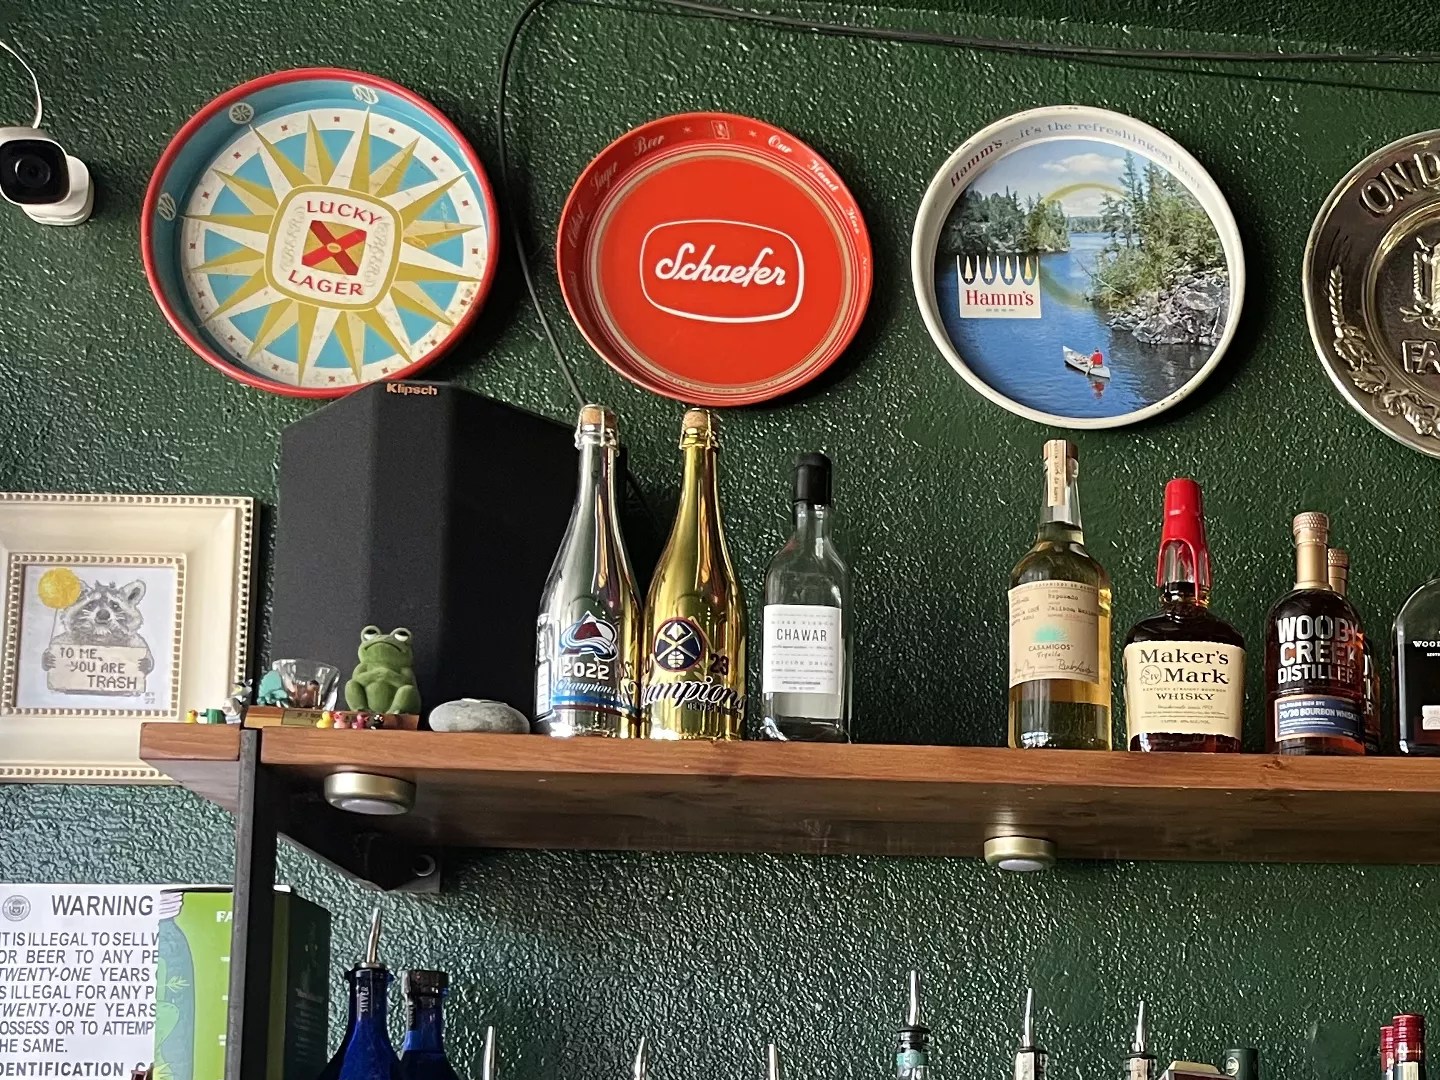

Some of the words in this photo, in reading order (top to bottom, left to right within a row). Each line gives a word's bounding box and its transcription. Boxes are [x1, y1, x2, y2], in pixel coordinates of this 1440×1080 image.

[1047, 121, 1072, 132] the
[1360, 162, 1419, 217] ON
[307, 200, 382, 225] LUCKY
[655, 242, 786, 288] Schaefer
[288, 269, 364, 296] LAGER
[965, 289, 1034, 307] Hamm's
[386, 382, 438, 396] Klipsch
[776, 628, 828, 642] CHAWAR
[1277, 615, 1360, 644] WOODY
[60, 647, 75, 659] TO
[1028, 643, 1071, 652] CASAMIGOS
[1280, 640, 1356, 668] CREEK
[1139, 649, 1229, 665] Maker's
[70, 661, 97, 673] YOU
[101, 661, 126, 674] ARE
[563, 662, 609, 681] 2022
[87, 675, 138, 690] TRASH
[1165, 668, 1229, 684] Mark
[1157, 692, 1215, 701] WHISKY
[51, 895, 153, 916] WARNING
[28, 932, 88, 947] ILLEGAL
[112, 932, 151, 946] SELL
[26, 950, 65, 964] BEER
[102, 950, 133, 965] ANY
[100, 967, 150, 982] YEARS
[10, 985, 71, 1000] ILLEGAL
[76, 985, 106, 1000] FOR
[110, 985, 146, 1000] ANY
[105, 1003, 157, 1018] YEARS
[22, 1039, 68, 1053] SAME.
